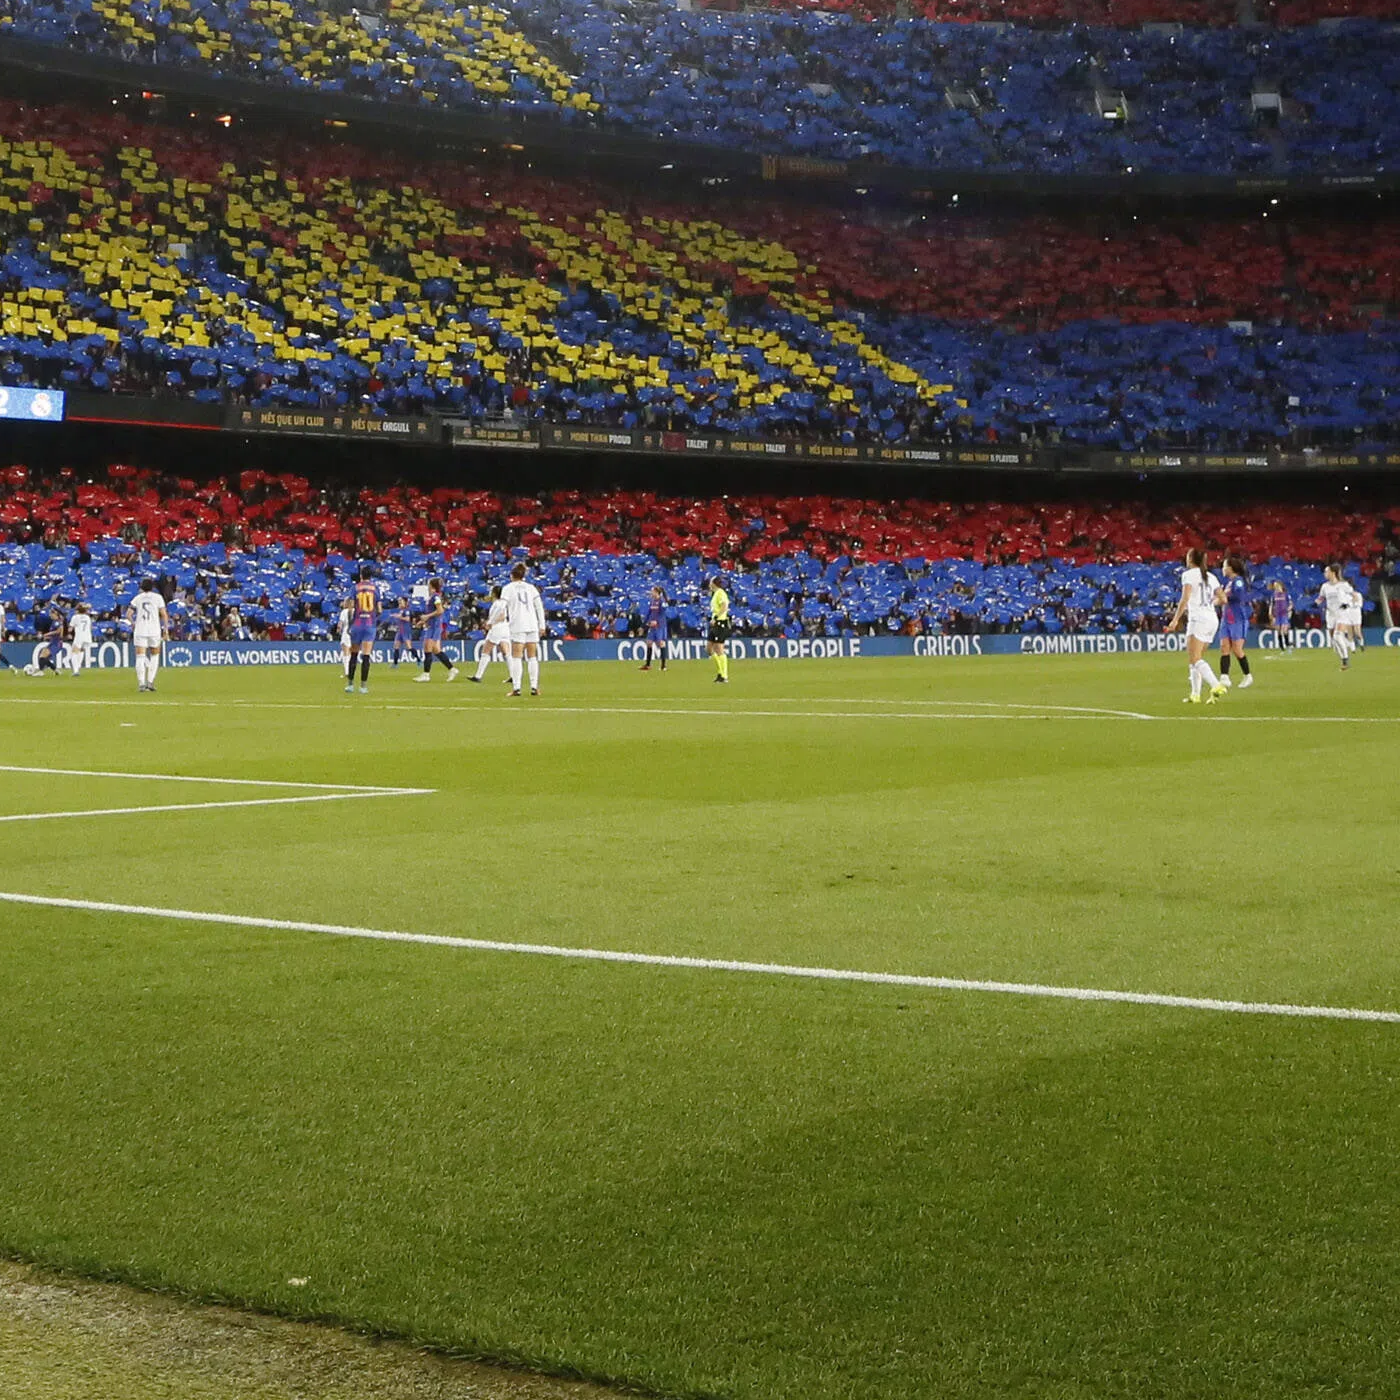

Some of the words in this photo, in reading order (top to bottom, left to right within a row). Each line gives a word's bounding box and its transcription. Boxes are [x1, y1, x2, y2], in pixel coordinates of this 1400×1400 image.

[260, 412, 275, 424] MÉS
[277, 415, 292, 427] QUE
[293, 416, 305, 426] UN
[306, 416, 324, 427] CLUB
[352, 417, 366, 430] MÉS
[367, 420, 382, 432] QUE
[382, 421, 410, 433] ORGULL
[609, 434, 631, 445] PROUD
[686, 439, 708, 449] TALENT
[766, 443, 786, 453] TALENT
[356, 591, 375, 612] 10
[752, 639, 780, 658] TO
[787, 638, 861, 658] PEOPLE
[913, 635, 982, 657] GRIFOLS
[1021, 634, 1117, 655] COMMITTED
[1121, 634, 1142, 653] TO
[1147, 634, 1188, 653] PEOP
[199, 650, 234, 664] UEFA
[236, 650, 300, 664] WOMEN'S
